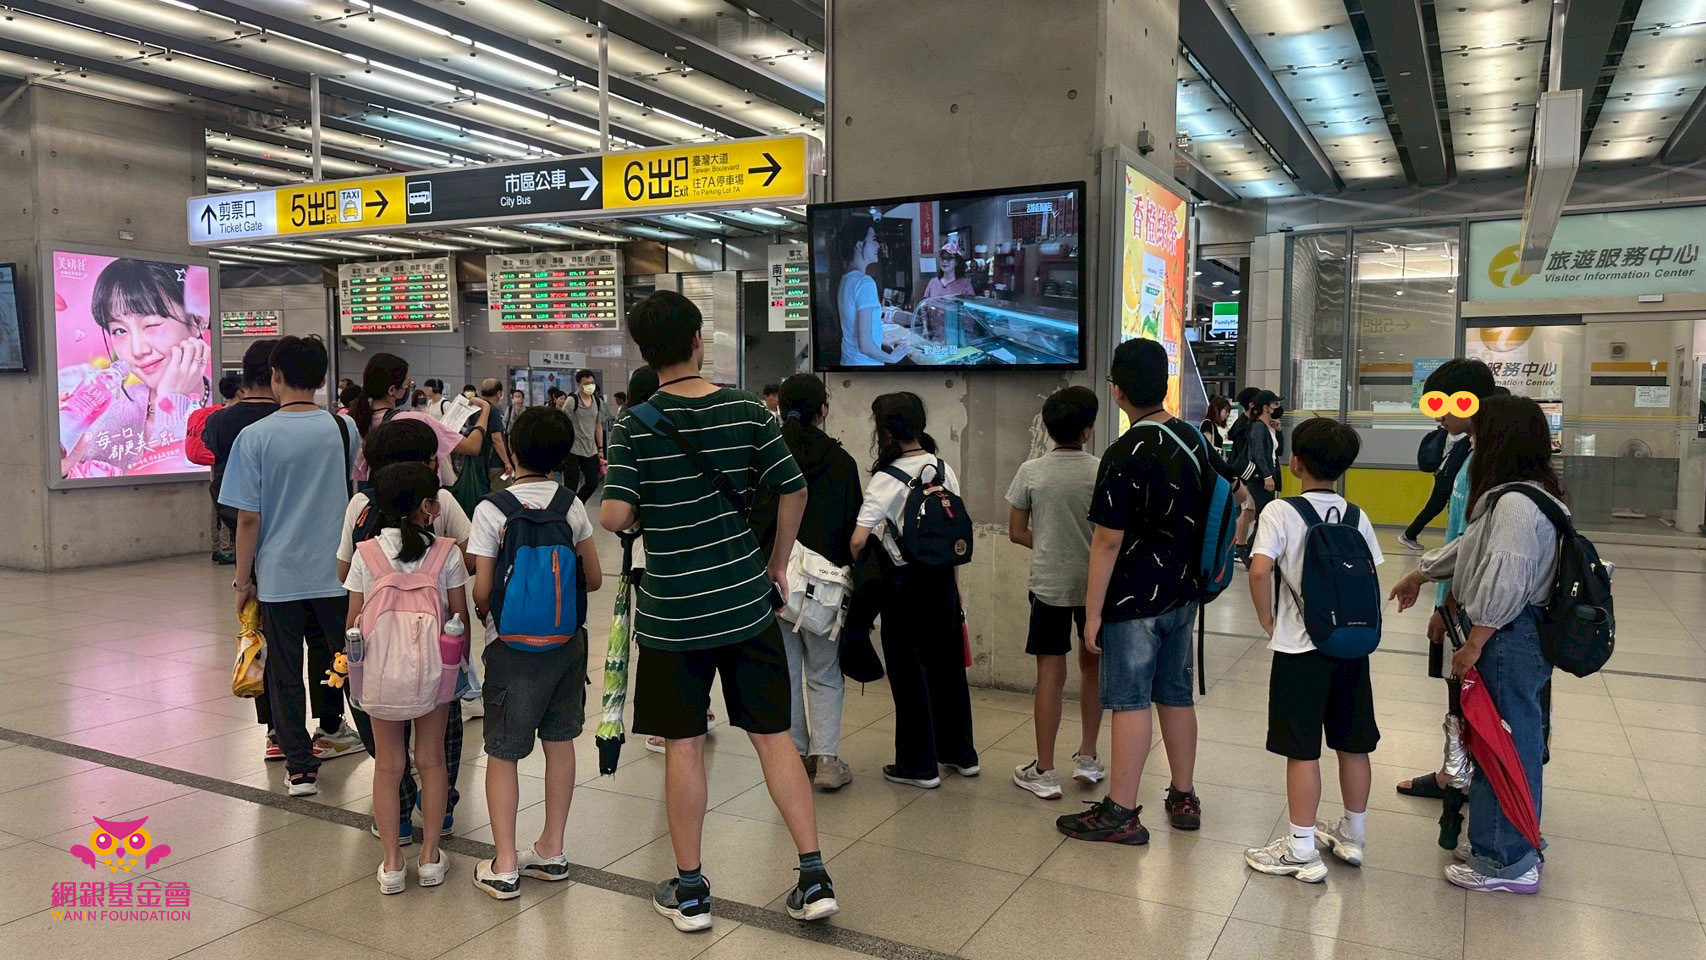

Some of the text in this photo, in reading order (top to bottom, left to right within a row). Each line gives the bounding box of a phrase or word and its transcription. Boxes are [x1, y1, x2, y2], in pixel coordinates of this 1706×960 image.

[692, 153, 728, 166] 臺灣大道
[692, 164, 740, 174] Taiwan Boulevard
[504, 169, 567, 193] 市區公車
[624, 156, 689, 201] 6出口
[692, 174, 744, 189] 往7A停車場
[341, 191, 360, 200] TAXI
[674, 185, 689, 198] Exit
[701, 188, 721, 197] Parking
[290, 190, 337, 227] 5出口
[500, 195, 531, 208] City Bus
[218, 200, 256, 221] 剪票口
[326, 214, 337, 225] Exit
[219, 221, 263, 234] Ticket Gate
[1546, 243, 1699, 271] 旅遊服務中心
[772, 264, 782, 286] 南下
[1545, 268, 1695, 283] Visitor Information Center
[96, 428, 134, 450] 每一口
